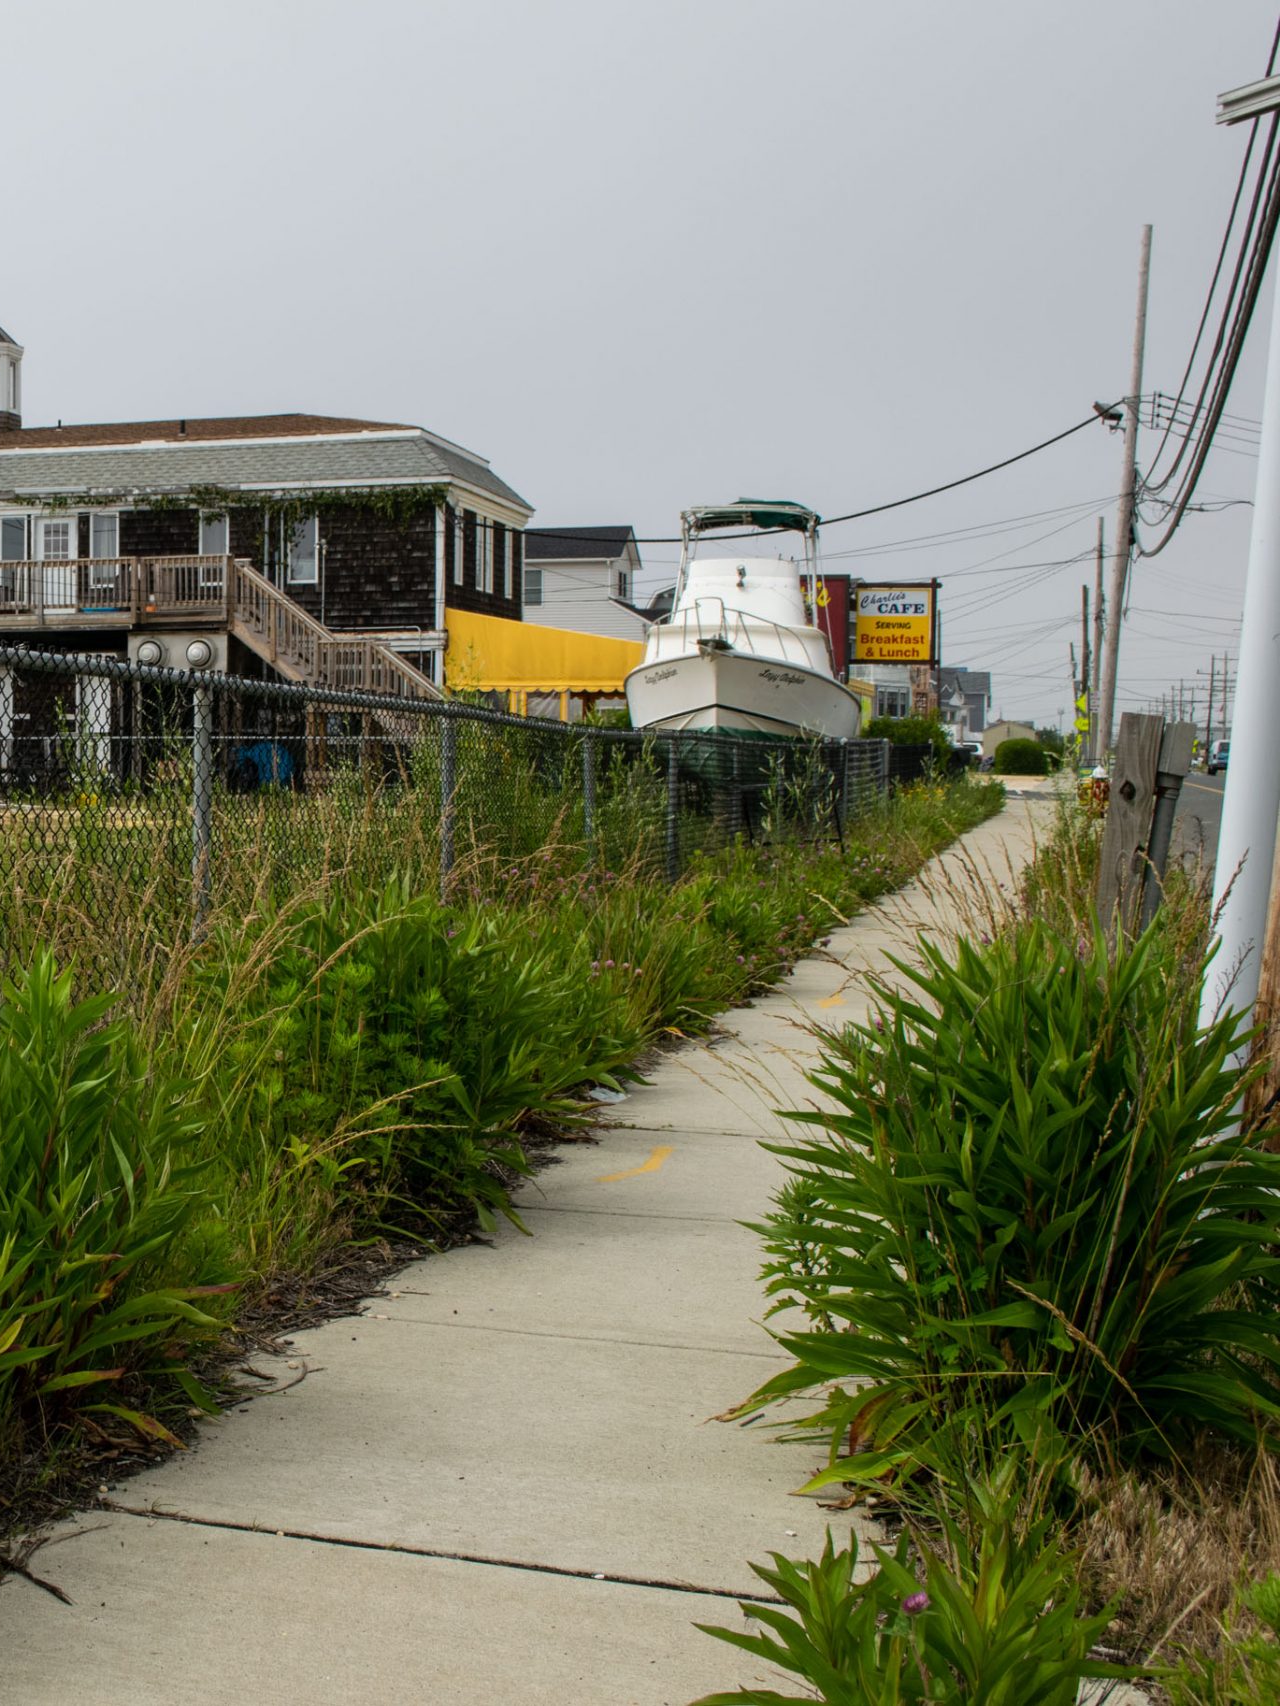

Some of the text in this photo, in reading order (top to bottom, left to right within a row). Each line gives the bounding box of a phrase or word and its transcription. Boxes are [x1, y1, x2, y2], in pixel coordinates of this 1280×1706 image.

[877, 603, 925, 614] CAFE
[875, 621, 912, 630] SERVING
[860, 633, 925, 645] Breakfast
[865, 647, 920, 657] & Lunch
